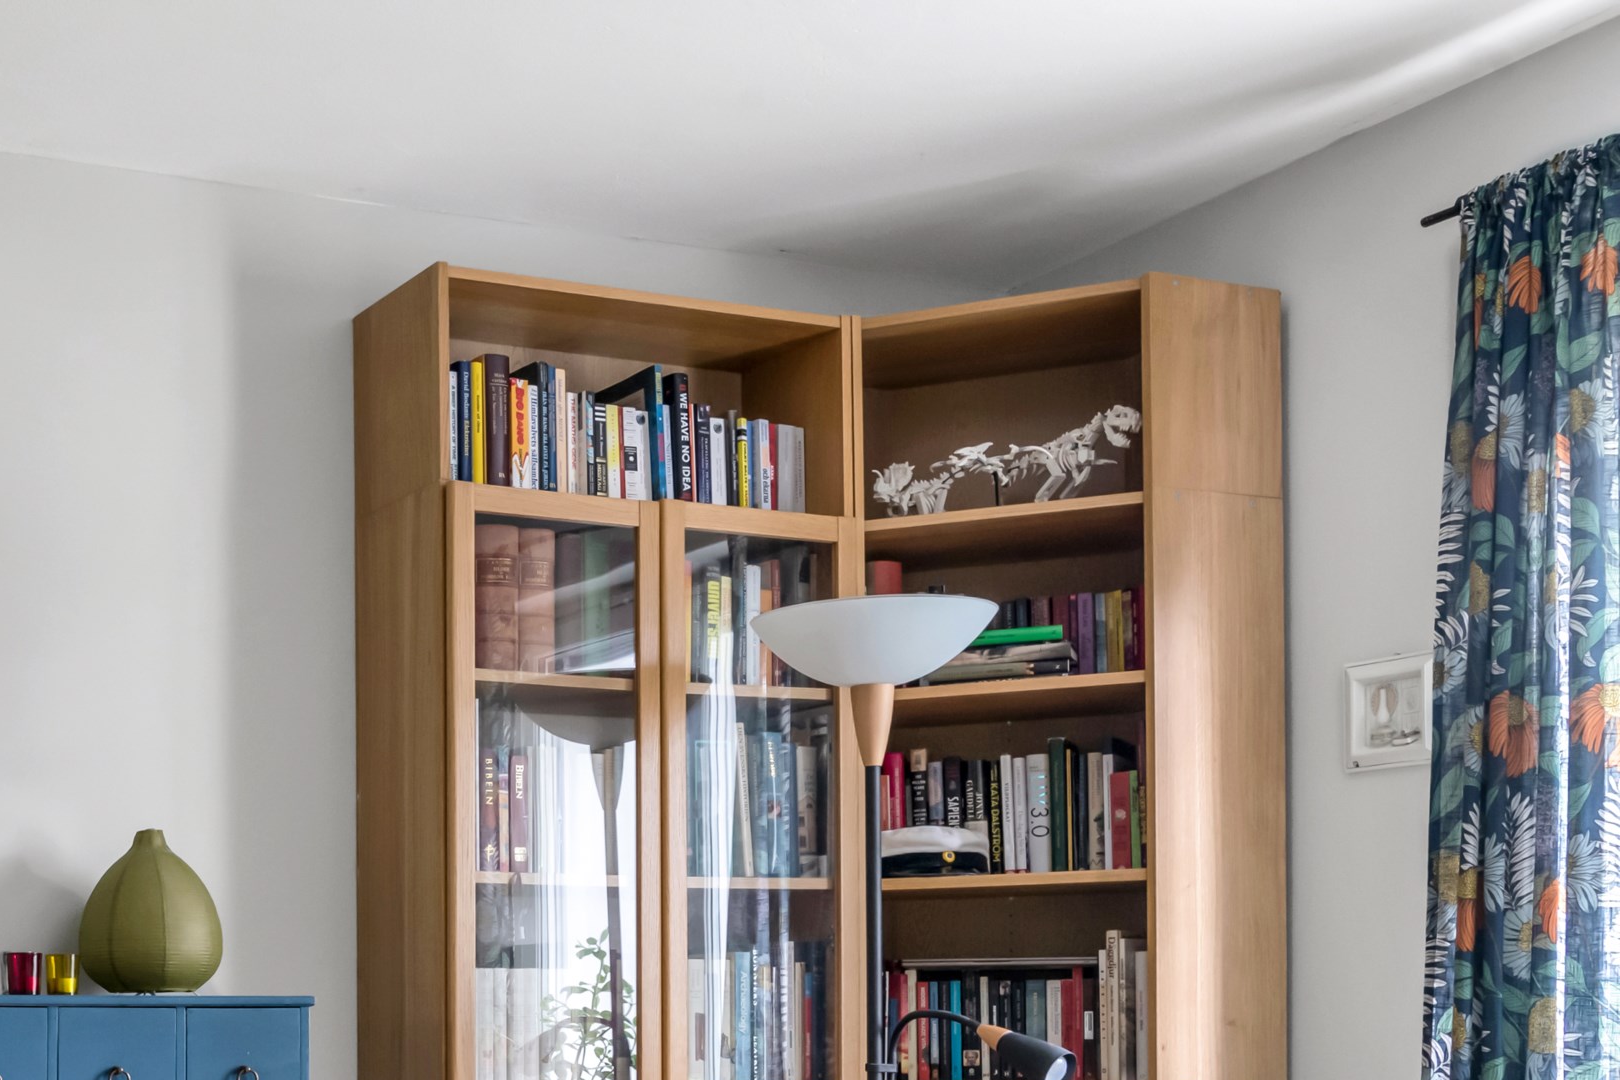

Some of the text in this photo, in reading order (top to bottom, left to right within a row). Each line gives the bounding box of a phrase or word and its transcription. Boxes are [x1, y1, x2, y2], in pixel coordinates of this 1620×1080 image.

[679, 392, 691, 491] WE HAVE NO IDEA
[762, 468, 770, 480] och
[485, 758, 494, 805] BIBELN
[515, 764, 524, 799] BIBELN
[965, 780, 973, 819] GARDELL
[975, 791, 984, 820] JONAS
[990, 783, 1001, 862] KATA DALSTRÖM
[1030, 807, 1050, 837] 3.0
[1107, 937, 1117, 979] Däggdjur
[738, 971, 749, 1034] Archaeology
